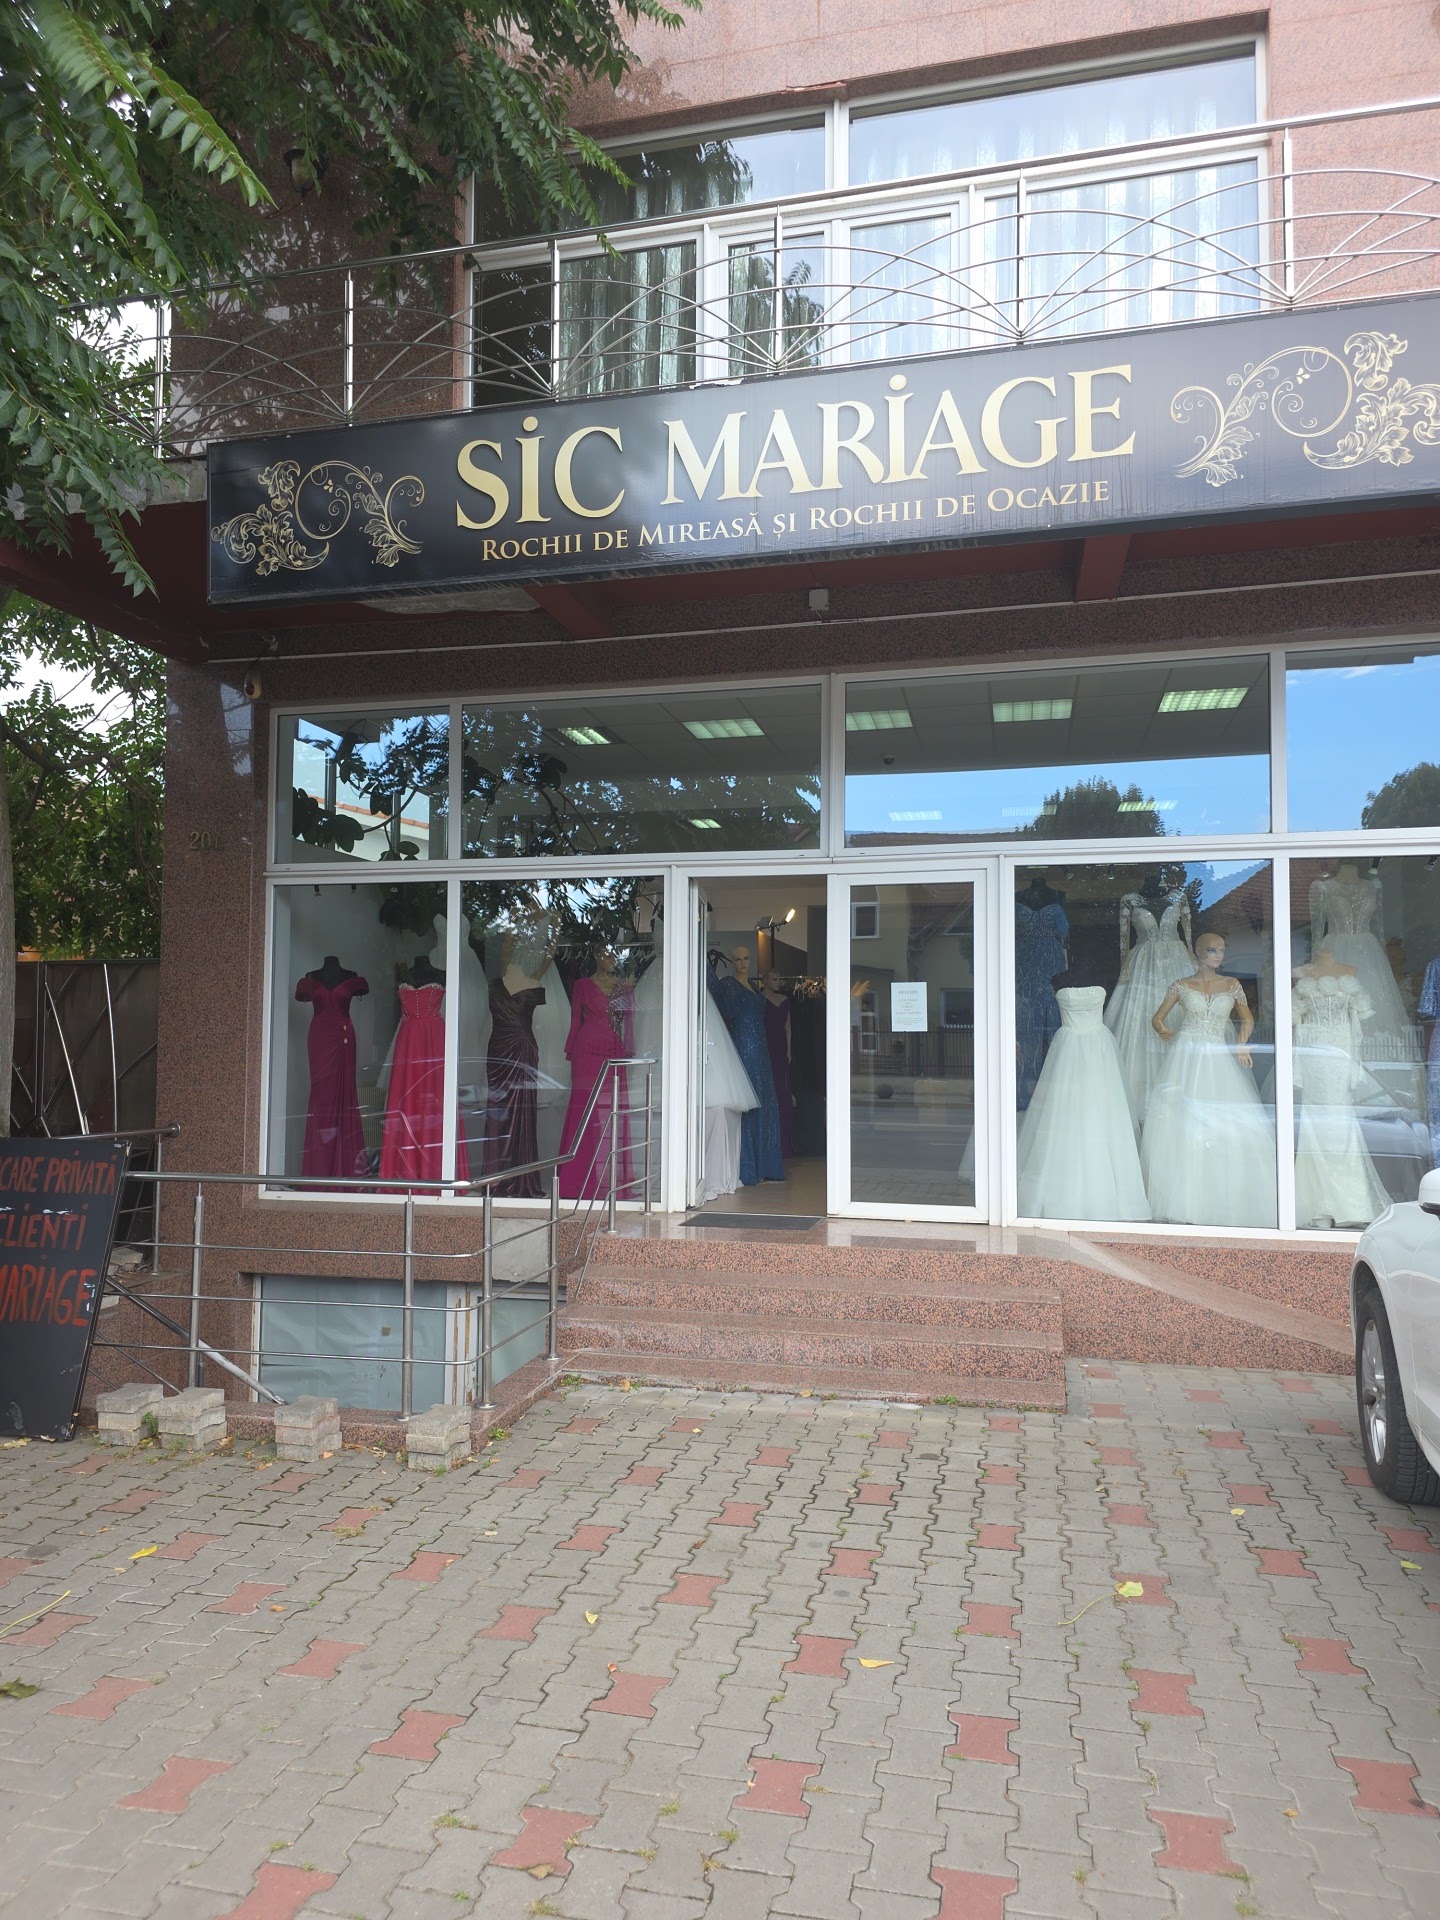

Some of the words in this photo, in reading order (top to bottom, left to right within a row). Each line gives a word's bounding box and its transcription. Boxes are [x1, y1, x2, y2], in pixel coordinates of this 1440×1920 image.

[481, 533, 583, 562] ROCHII
[593, 529, 629, 551] DE
[638, 511, 764, 547] MIREASĂ
[808, 499, 923, 531] ROCHII
[936, 494, 976, 518] DE
[987, 480, 1109, 513] OCAZIE
